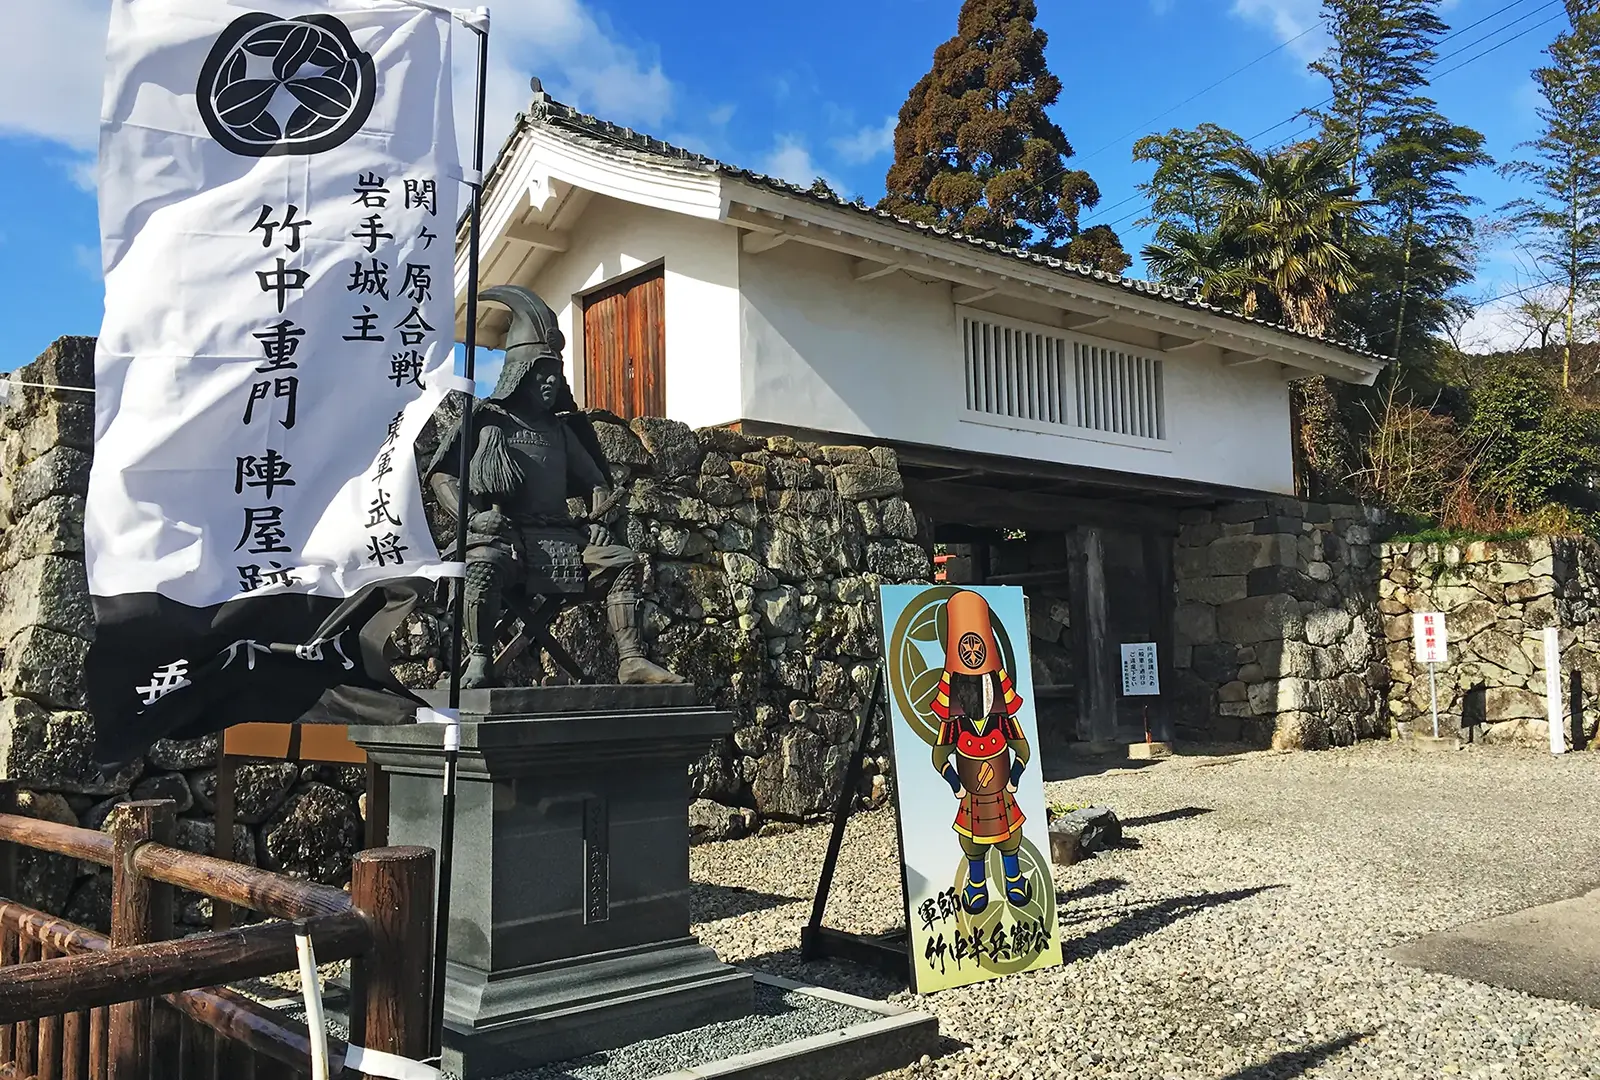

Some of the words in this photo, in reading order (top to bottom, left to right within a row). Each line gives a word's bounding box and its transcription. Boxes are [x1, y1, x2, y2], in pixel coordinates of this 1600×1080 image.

[242, 204, 313, 430] 竹中重門
[342, 171, 394, 343] 岩手城主
[387, 178, 438, 391] 関ヶ原合戦
[364, 411, 410, 567] 東軍武将
[1423, 615, 1437, 661] 駐車禁止
[917, 886, 962, 932] 軍師
[924, 916, 1052, 975] 竹中半兵衛公
